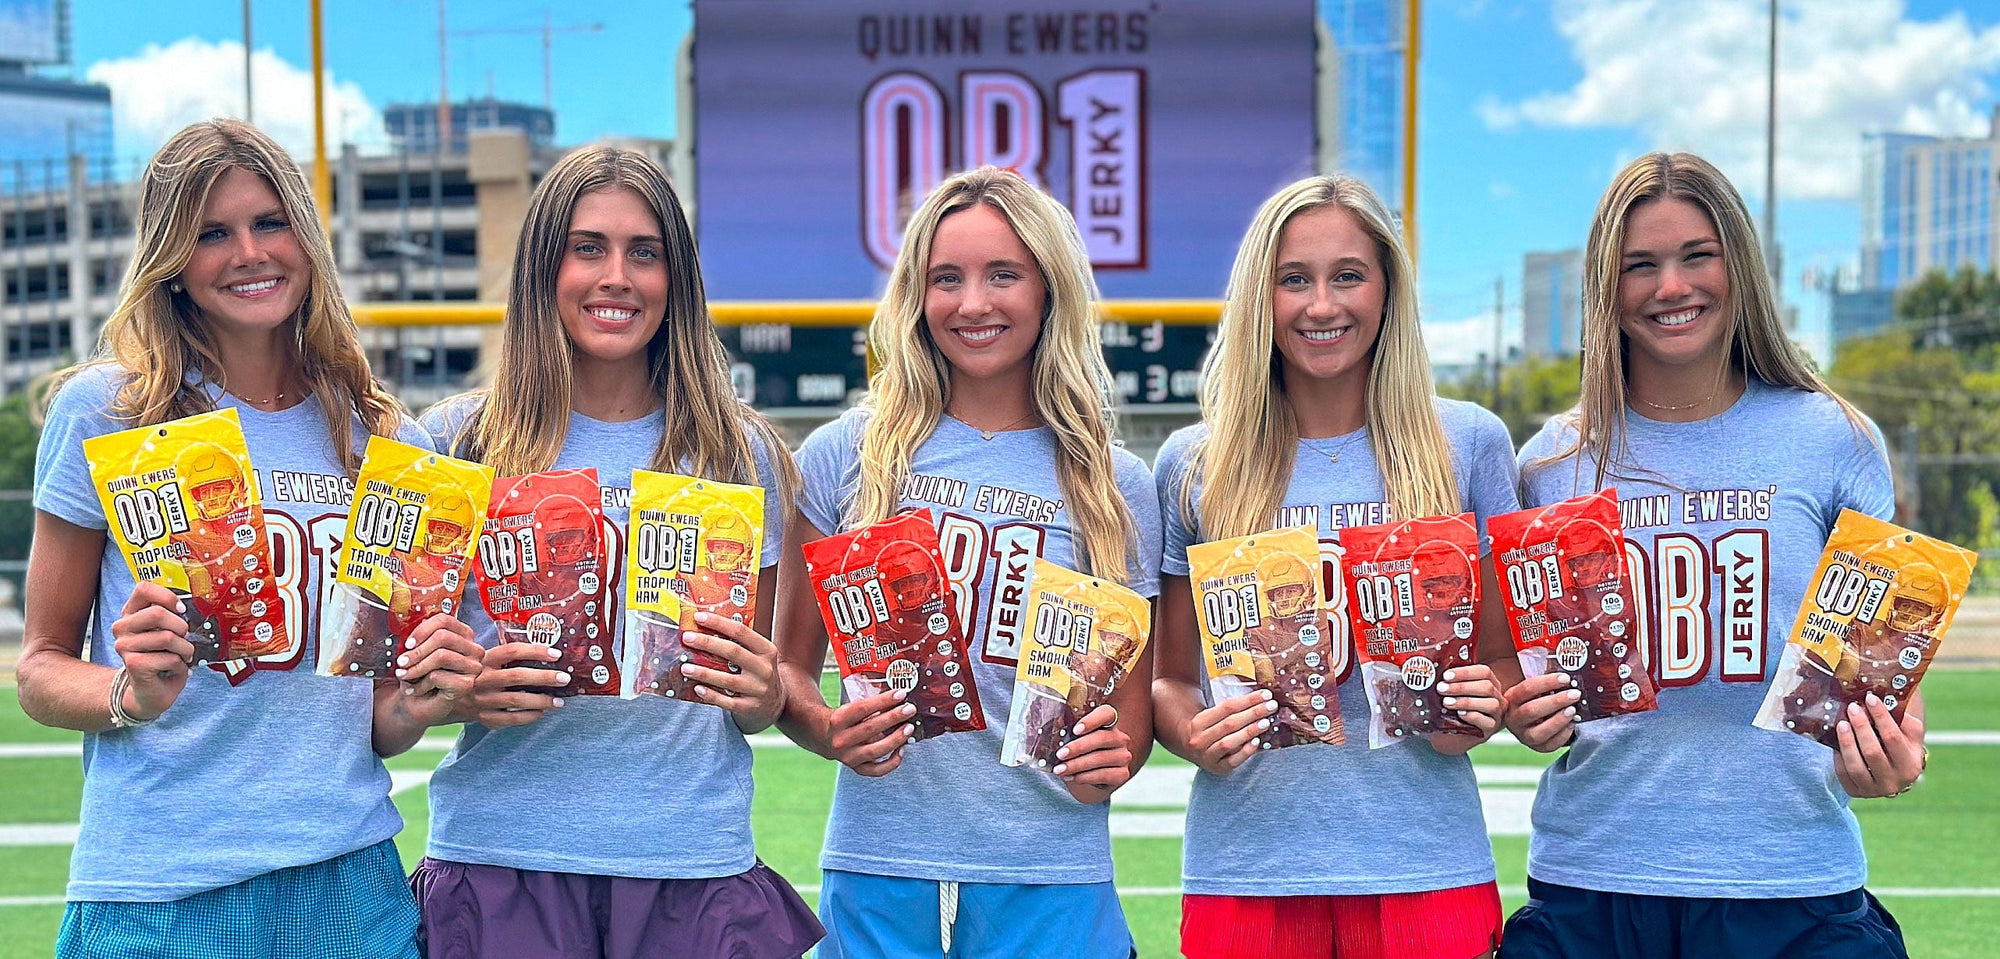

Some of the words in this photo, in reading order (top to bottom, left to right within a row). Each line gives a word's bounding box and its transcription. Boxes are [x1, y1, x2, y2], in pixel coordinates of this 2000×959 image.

[859, 14, 982, 62] QUINN
[1090, 97, 1123, 244] JERKY
[1145, 364, 1169, 403] 3
[108, 476, 138, 494] QUINN
[366, 480, 395, 495] QUINN
[113, 481, 190, 548] QB1
[170, 490, 184, 527] JERKY
[639, 510, 666, 523] QUINN
[973, 486, 1064, 523] EWERS'
[1618, 495, 1670, 530] UINN
[1683, 484, 1778, 524] EWERS'
[354, 494, 422, 554] QB1
[399, 509, 415, 547] JERKY
[1276, 505, 1319, 532] INN
[131, 541, 190, 566] TROPICAL
[350, 548, 403, 574] TROPICAL
[478, 527, 539, 581] QB1
[524, 533, 534, 568] JERKY
[638, 523, 698, 574] QB1
[682, 533, 693, 568] JERKY
[1501, 550, 1527, 565] QUINN
[1833, 550, 1860, 568] QUINN
[138, 565, 161, 581] HAM
[347, 564, 373, 581] HAM
[822, 573, 848, 591] QUINN
[1352, 563, 1378, 577] QUINN
[1506, 554, 1564, 610] QB1
[1550, 561, 1560, 594] JERKY
[248, 581, 261, 591] GF
[488, 584, 518, 600] TEXAS
[637, 576, 689, 593] TROPICAL
[897, 507, 1045, 668] B1
[997, 538, 1029, 647] JERKY
[1200, 577, 1224, 592] QUINN
[1401, 578, 1411, 613] JERKY
[1816, 563, 1889, 625] QB1
[490, 598, 513, 613] HEAT
[518, 594, 542, 610] HAM
[636, 591, 659, 604] HAM
[828, 577, 890, 636] QB1
[872, 585, 887, 618] JERKY
[1040, 591, 1064, 606] QUINN
[1245, 590, 1257, 623] JERKY
[1356, 572, 1415, 624] QB1
[1733, 550, 1754, 662] JERKY
[1864, 583, 1883, 618] JERKY
[1202, 584, 1262, 640] QB1
[1517, 611, 1548, 628] TEXAS
[532, 631, 554, 645] HOT
[1033, 602, 1091, 655] QB1
[1077, 620, 1087, 650] JERKY
[1365, 628, 1394, 641] TEXAS
[1521, 627, 1544, 643] HEAT
[1547, 618, 1569, 636] HAM
[1801, 628, 1826, 645] HAM
[843, 633, 876, 653] TEXAS
[846, 650, 873, 668] HEAT
[876, 642, 899, 661] HAM
[1367, 641, 1389, 656] HEAT
[1394, 639, 1418, 653] HAM
[1614, 646, 1624, 654] GF
[945, 664, 956, 674] GF
[1028, 664, 1052, 678] HAM
[1562, 654, 1581, 667] HOT
[892, 677, 913, 690] HOT
[1309, 677, 1321, 685] GF
[1407, 673, 1429, 687] HOT
[1885, 698, 1895, 707] GF
